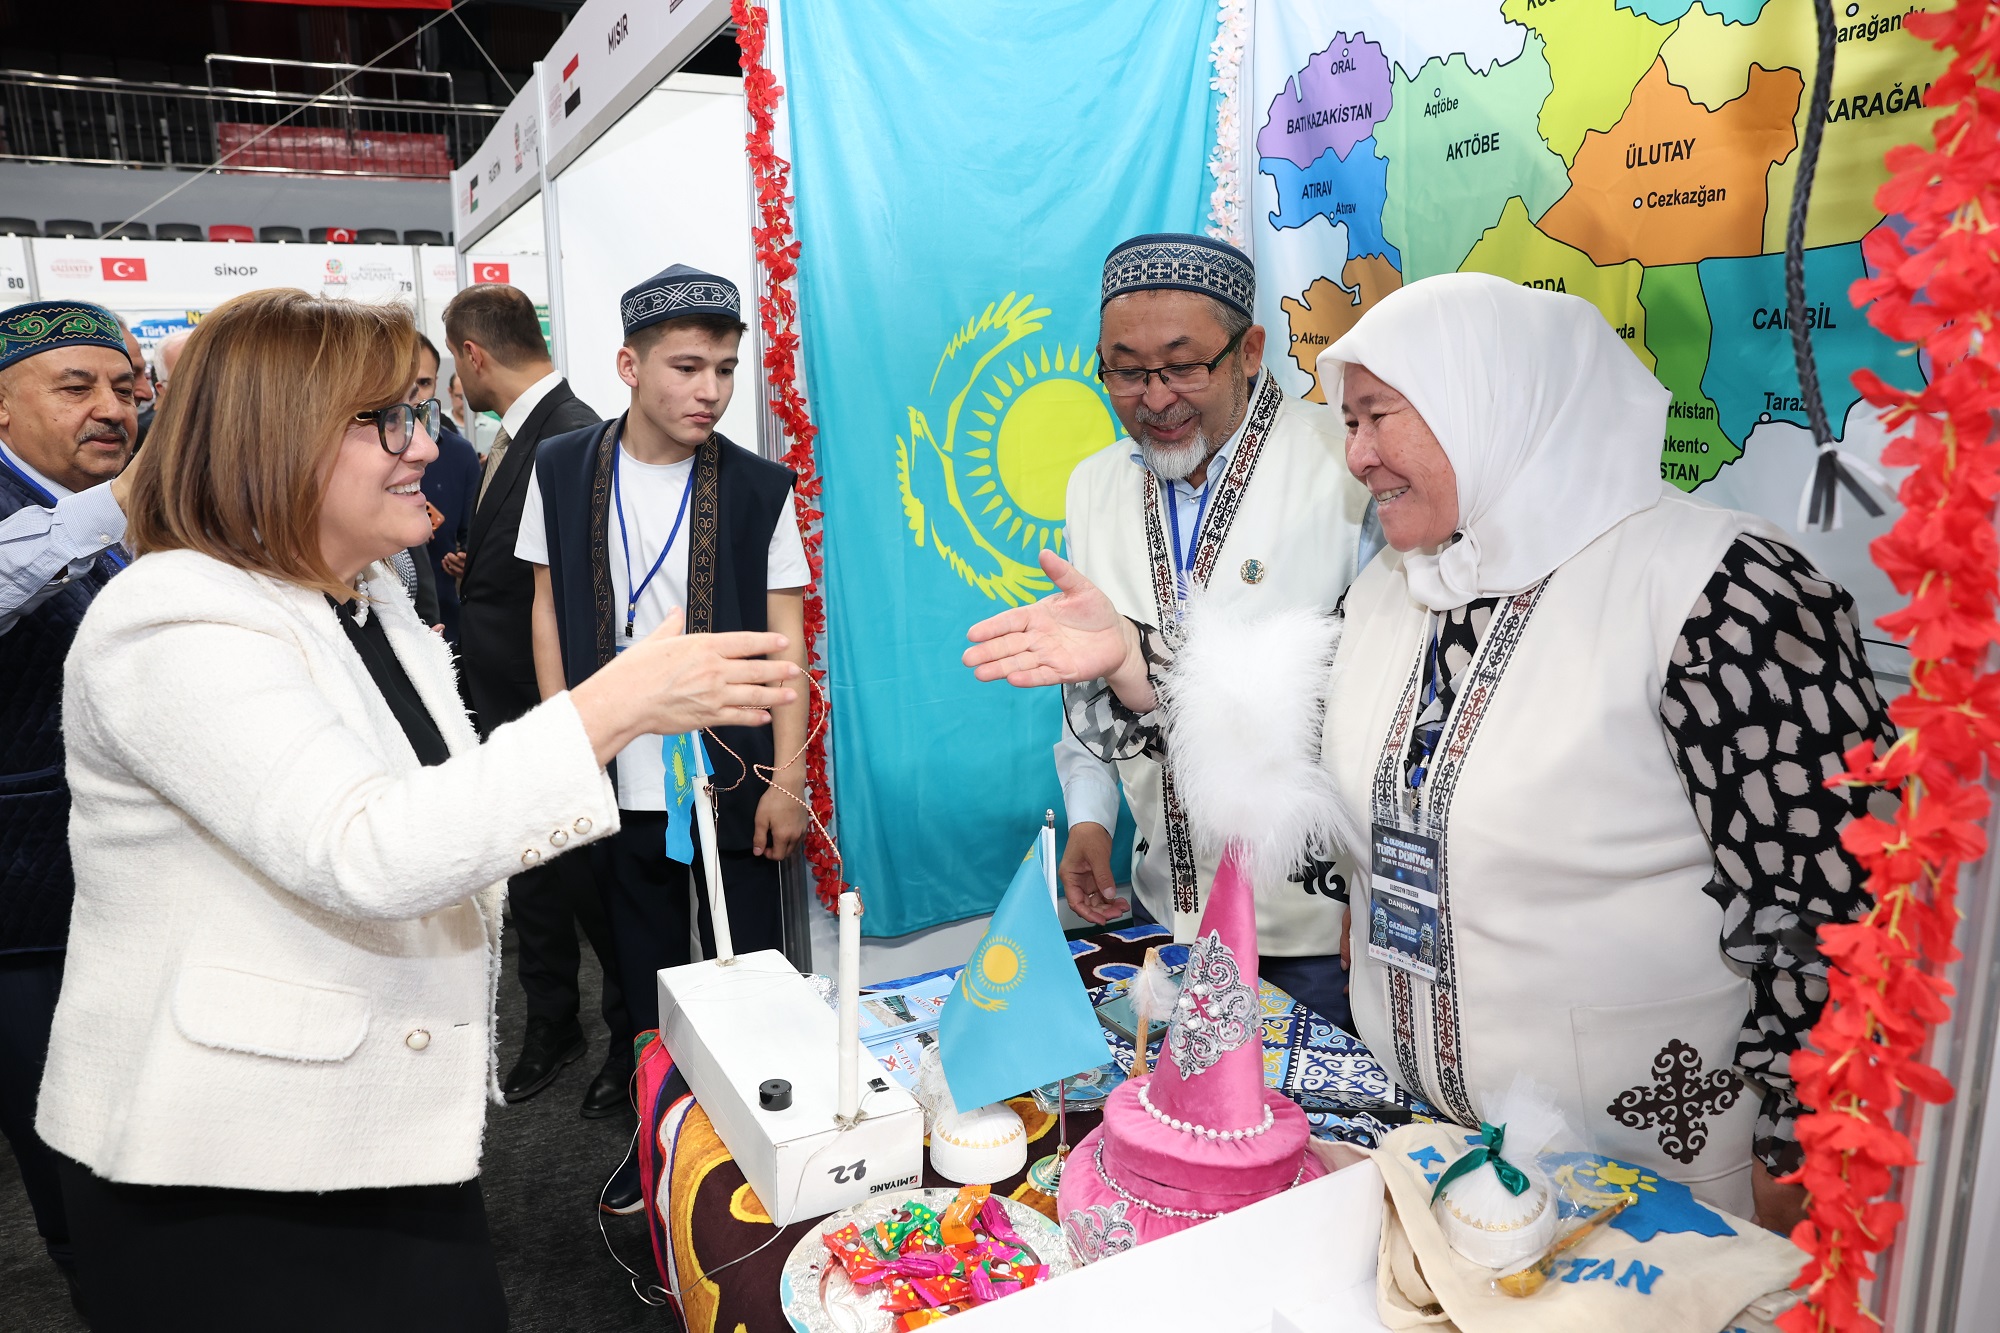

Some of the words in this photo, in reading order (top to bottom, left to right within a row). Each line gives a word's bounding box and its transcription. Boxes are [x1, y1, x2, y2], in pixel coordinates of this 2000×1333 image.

[608, 13, 628, 55] MISIR
[1836, 6, 1925, 43] arağan
[1331, 58, 1356, 76] ORAL
[1424, 97, 1459, 118] Aqtöbe
[1287, 116, 1307, 134] BATI
[1307, 102, 1372, 130] KAZAKİSTAN
[1446, 132, 1500, 162] AKTÖBE
[1626, 138, 1696, 169] ÜLUTAY
[1302, 180, 1332, 199] ATIRAV
[1647, 185, 1726, 208] Cezkazğan
[214, 263, 258, 277] SİNOP
[8, 277, 24, 288] 80
[399, 281, 412, 292] 79
[1300, 332, 1330, 345] Aktav
[1376, 843, 1397, 859] TÜRK
[1398, 849, 1434, 869] DÜNYASI
[1388, 898, 1420, 914] DANIŞMAN
[870, 1178, 909, 1194] MIYANG
